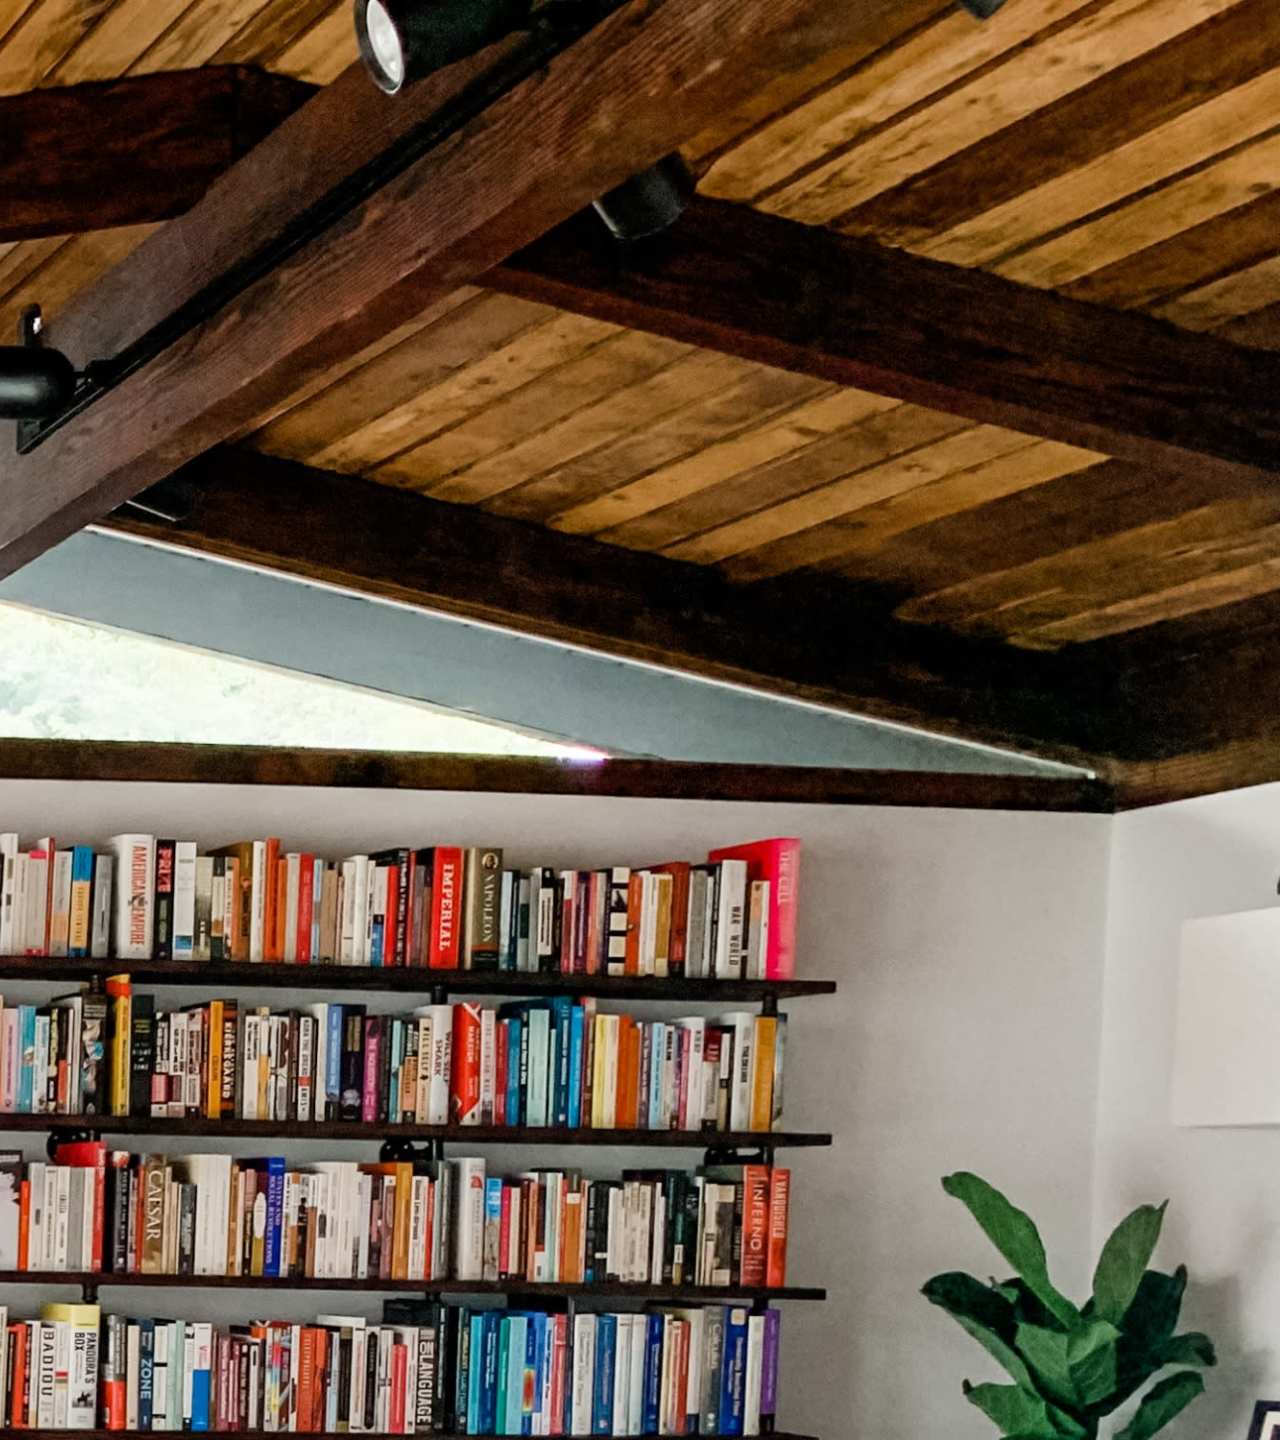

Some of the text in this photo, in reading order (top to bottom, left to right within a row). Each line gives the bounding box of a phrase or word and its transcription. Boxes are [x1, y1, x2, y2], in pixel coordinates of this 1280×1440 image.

[131, 846, 147, 945] AMERICAN EMPIRE
[157, 848, 171, 893] PRIZE
[439, 864, 456, 951] IMPERIAL
[482, 873, 494, 942] NAPOLEON
[146, 1170, 162, 1240] CAESAR
[750, 1184, 765, 1250] INFERNO
[772, 1181, 786, 1239] VANQUISHED
[42, 1331, 54, 1396] BADIOU
[74, 1332, 86, 1351] BOX
[84, 1332, 96, 1384] PANDORA'S
[140, 1358, 152, 1399] ZONE
[417, 1355, 435, 1423] LANGUAGE
